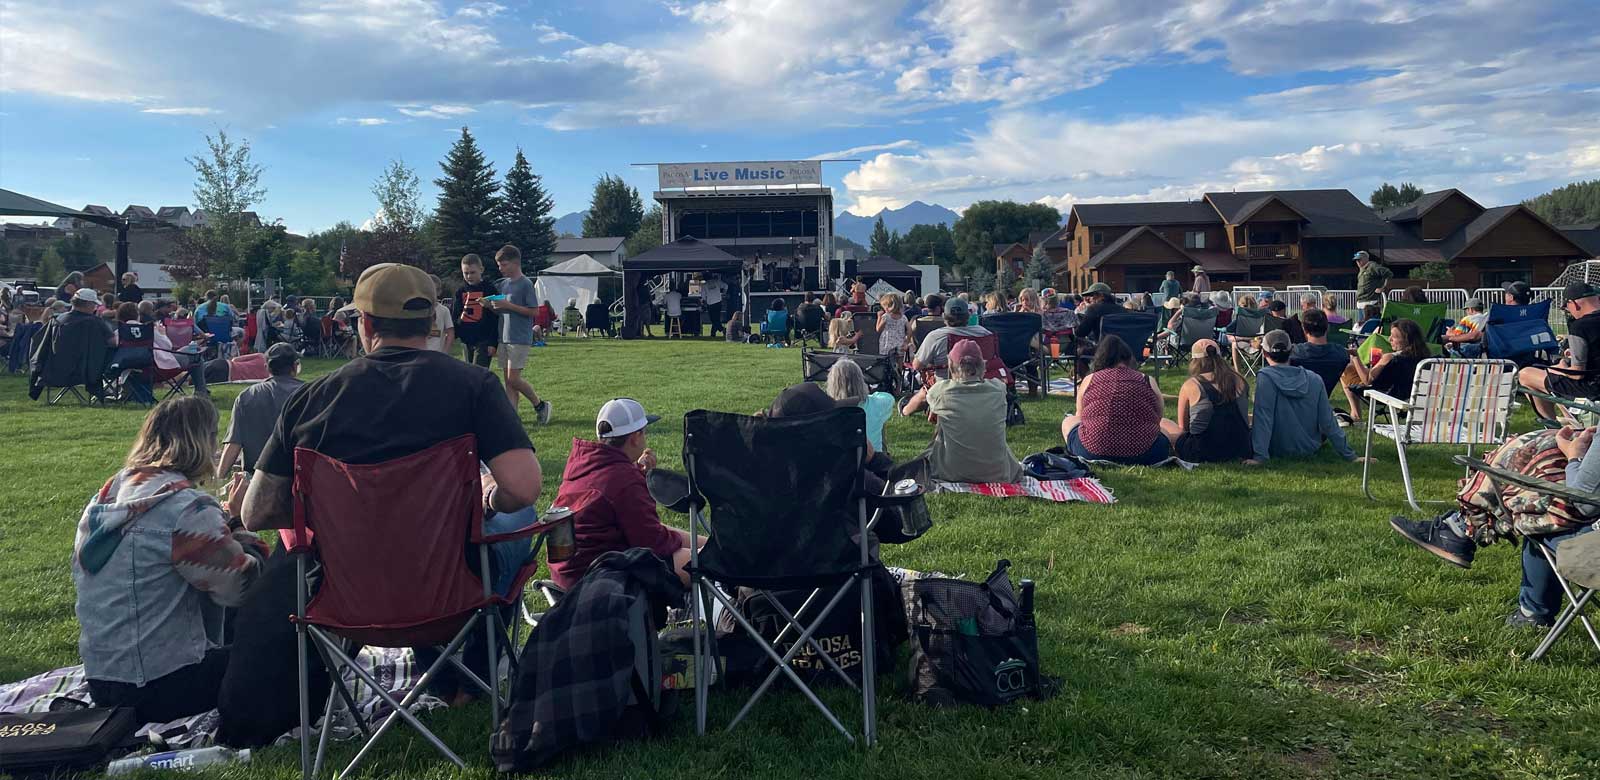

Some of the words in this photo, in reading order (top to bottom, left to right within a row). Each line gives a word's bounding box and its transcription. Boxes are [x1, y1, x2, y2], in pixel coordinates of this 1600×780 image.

[694, 168, 729, 181] Live
[735, 167, 785, 180] Music
[996, 669, 1025, 692] CCI
[0, 723, 56, 732] AGOSA
[150, 754, 194, 770] smart
